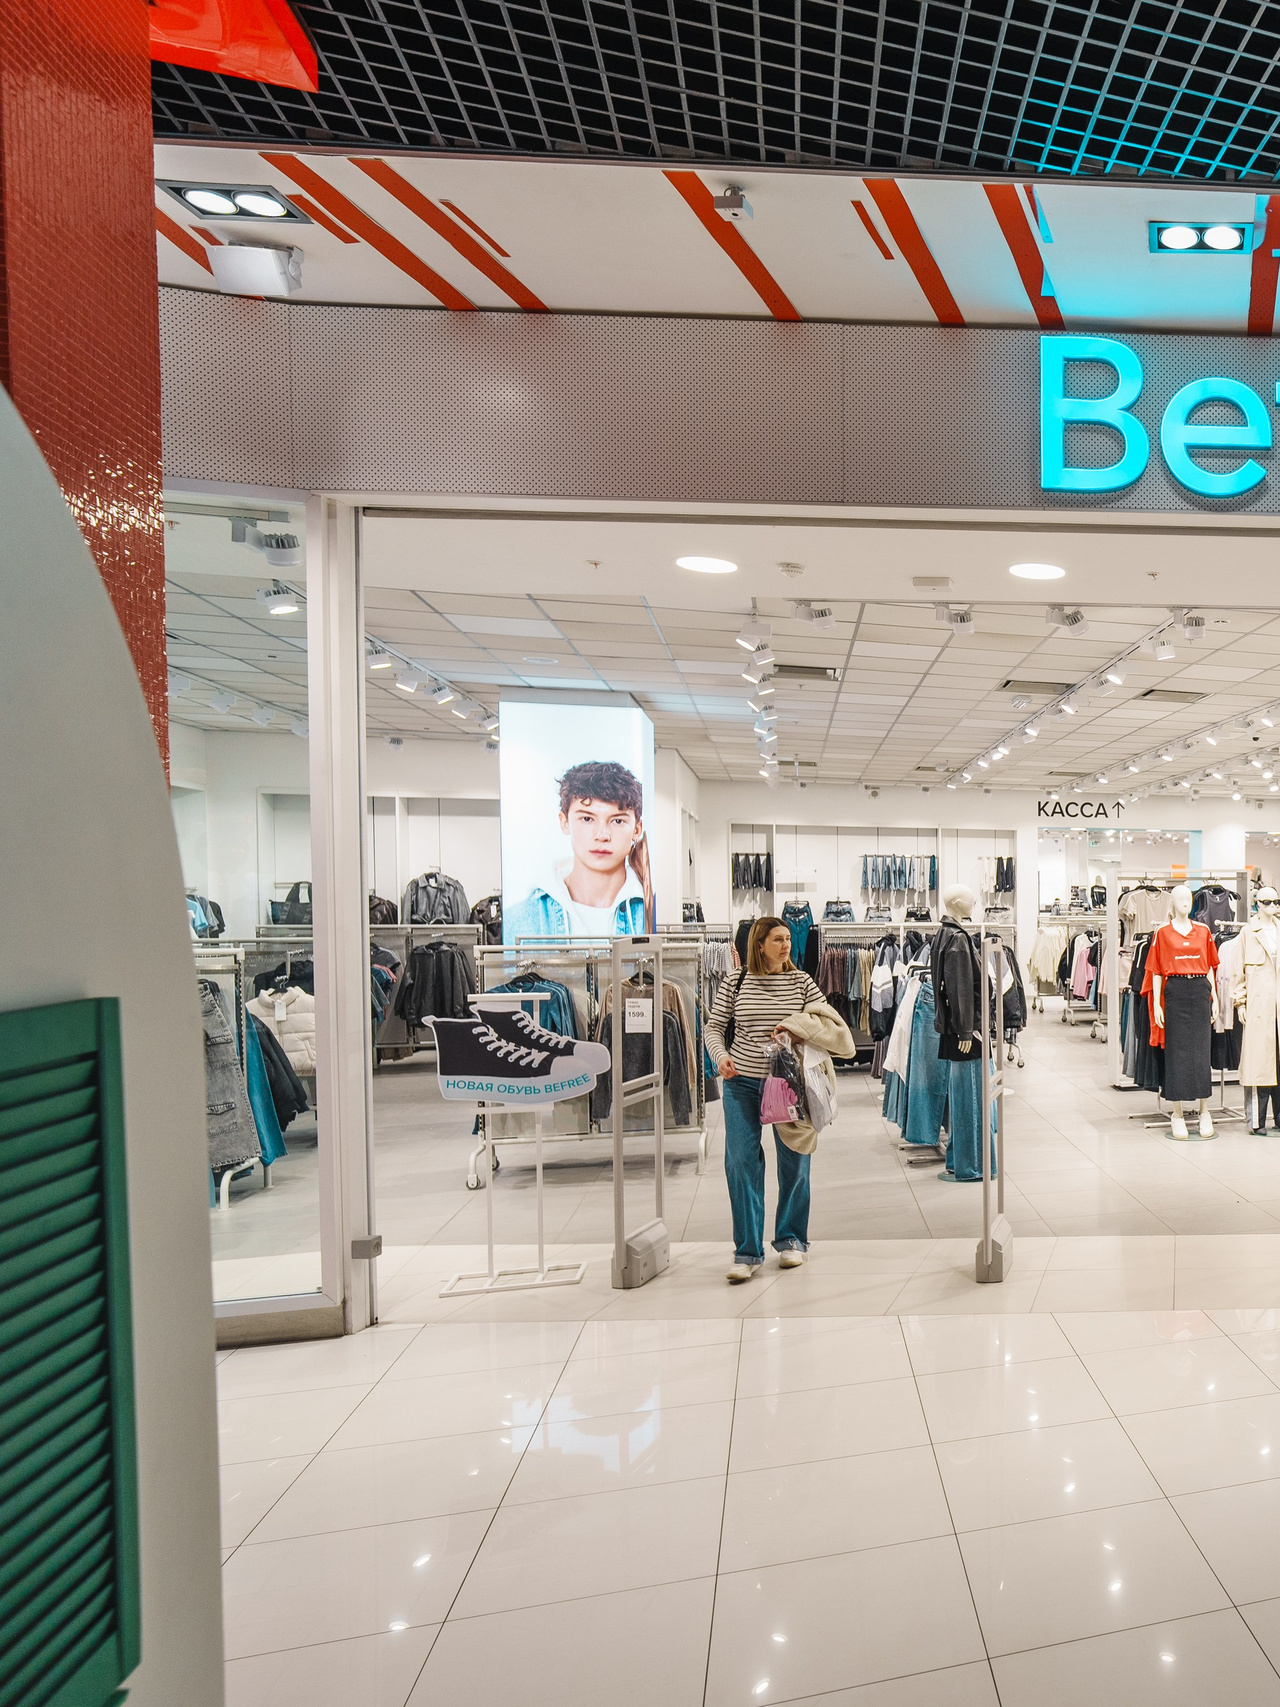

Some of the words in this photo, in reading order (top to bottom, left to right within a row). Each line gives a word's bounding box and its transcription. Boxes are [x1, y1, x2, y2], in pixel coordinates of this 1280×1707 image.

[1037, 801, 1109, 818] КАССА
[446, 1079, 493, 1092] НОВАЯ
[497, 1084, 541, 1095] ОБУВЬ
[544, 1073, 591, 1094] BEFREE
